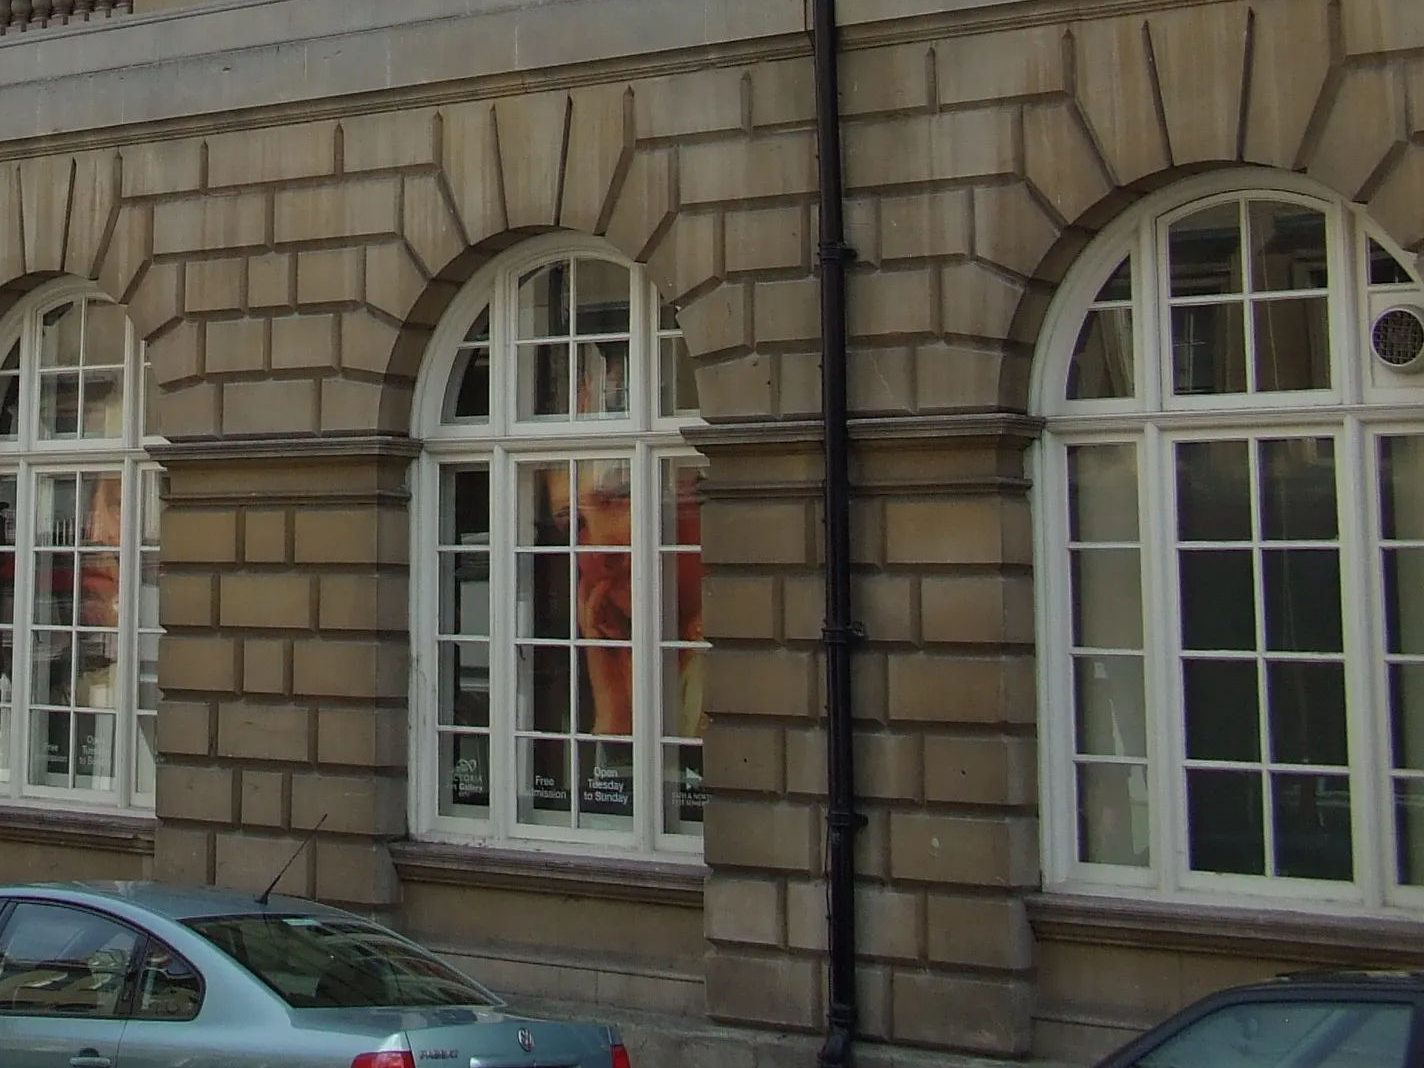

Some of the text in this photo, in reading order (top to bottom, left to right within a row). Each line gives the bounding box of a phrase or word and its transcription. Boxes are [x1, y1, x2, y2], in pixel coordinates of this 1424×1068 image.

[593, 766, 618, 778] Open
[536, 775, 555, 786] Free
[587, 778, 624, 792] Tuesday
[583, 791, 629, 805] to Sunday
